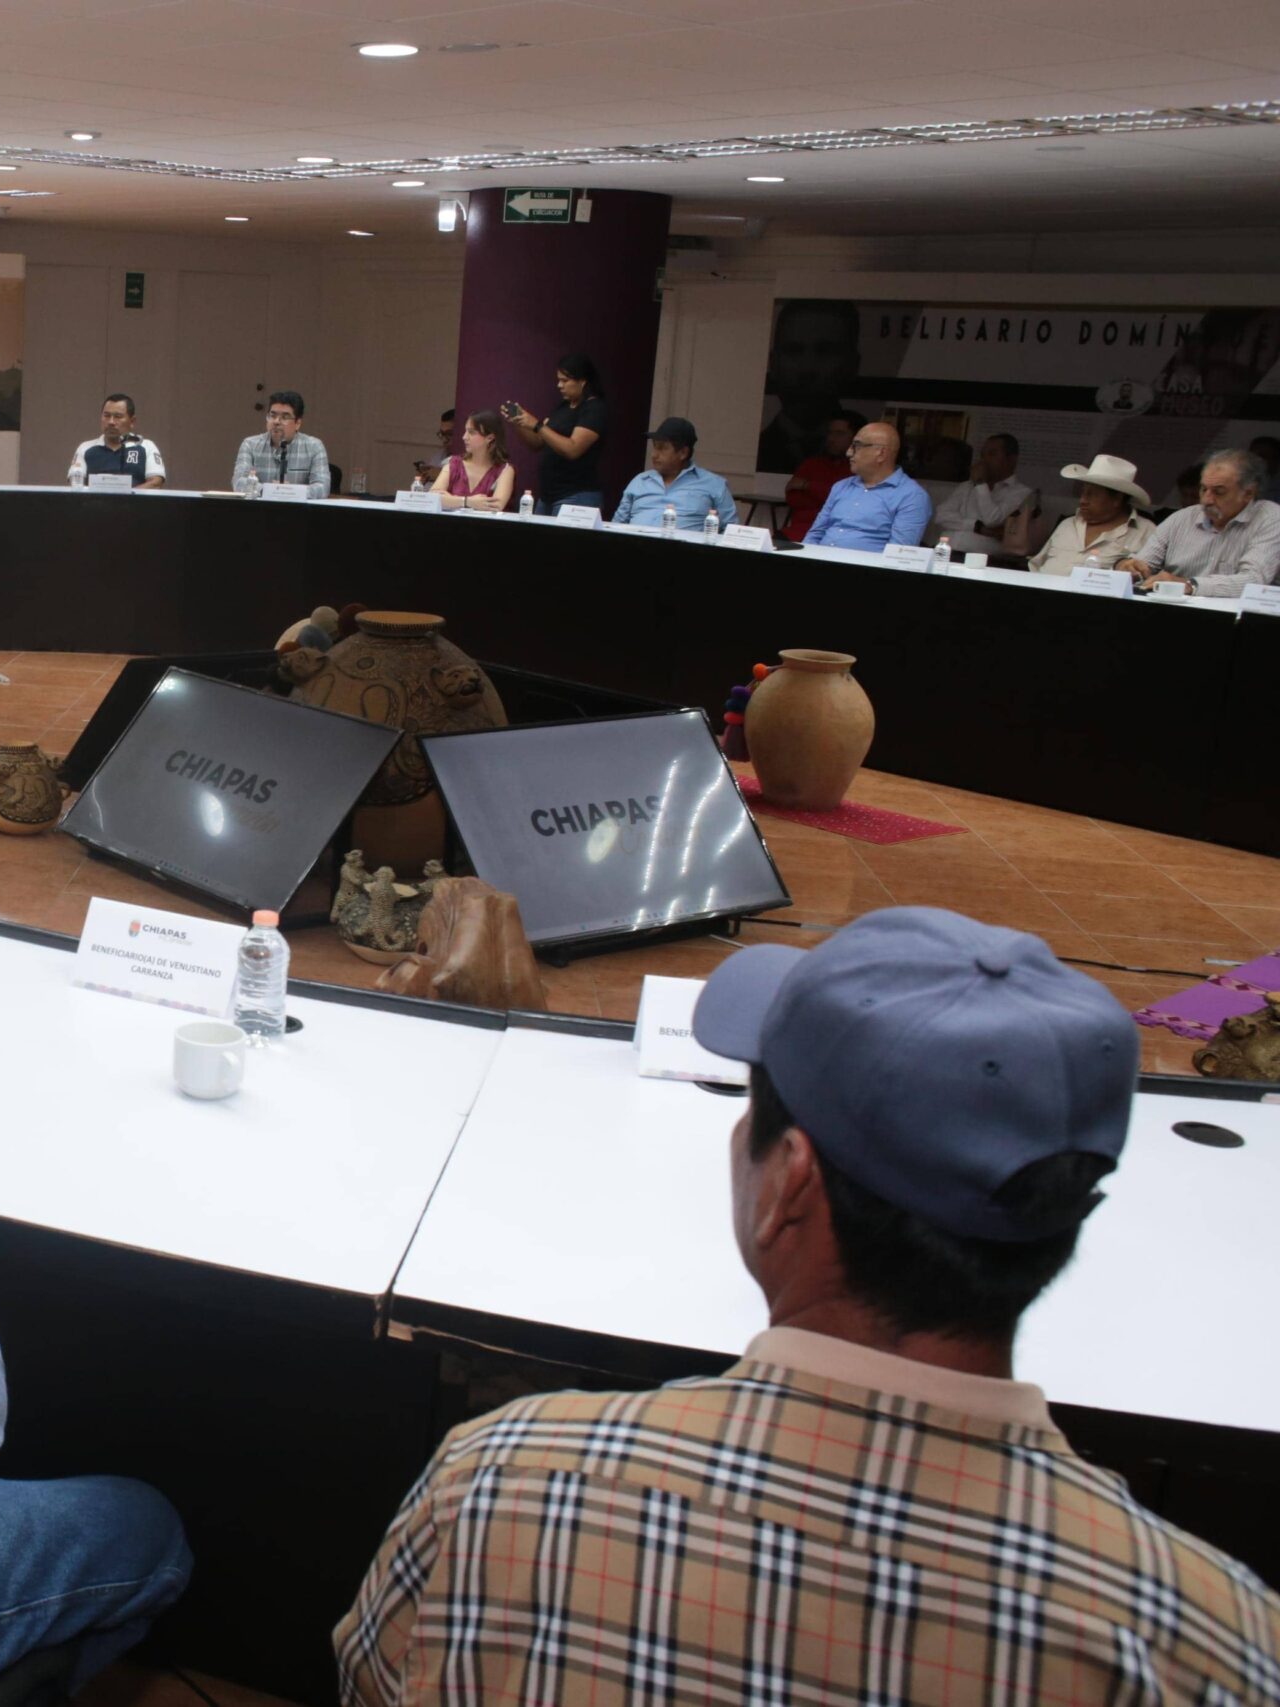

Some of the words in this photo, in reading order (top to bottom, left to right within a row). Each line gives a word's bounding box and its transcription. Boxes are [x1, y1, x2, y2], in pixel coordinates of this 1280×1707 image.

[880, 314, 1052, 344] BELISARIO
[165, 749, 278, 804] CHIAPAS
[142, 923, 187, 940] CHIAPAS
[91, 943, 156, 965] BENEFICIARIO(A)
[156, 958, 167, 967] DE
[169, 960, 222, 979] VENUSTIANO
[130, 965, 174, 981] CARRANZA
